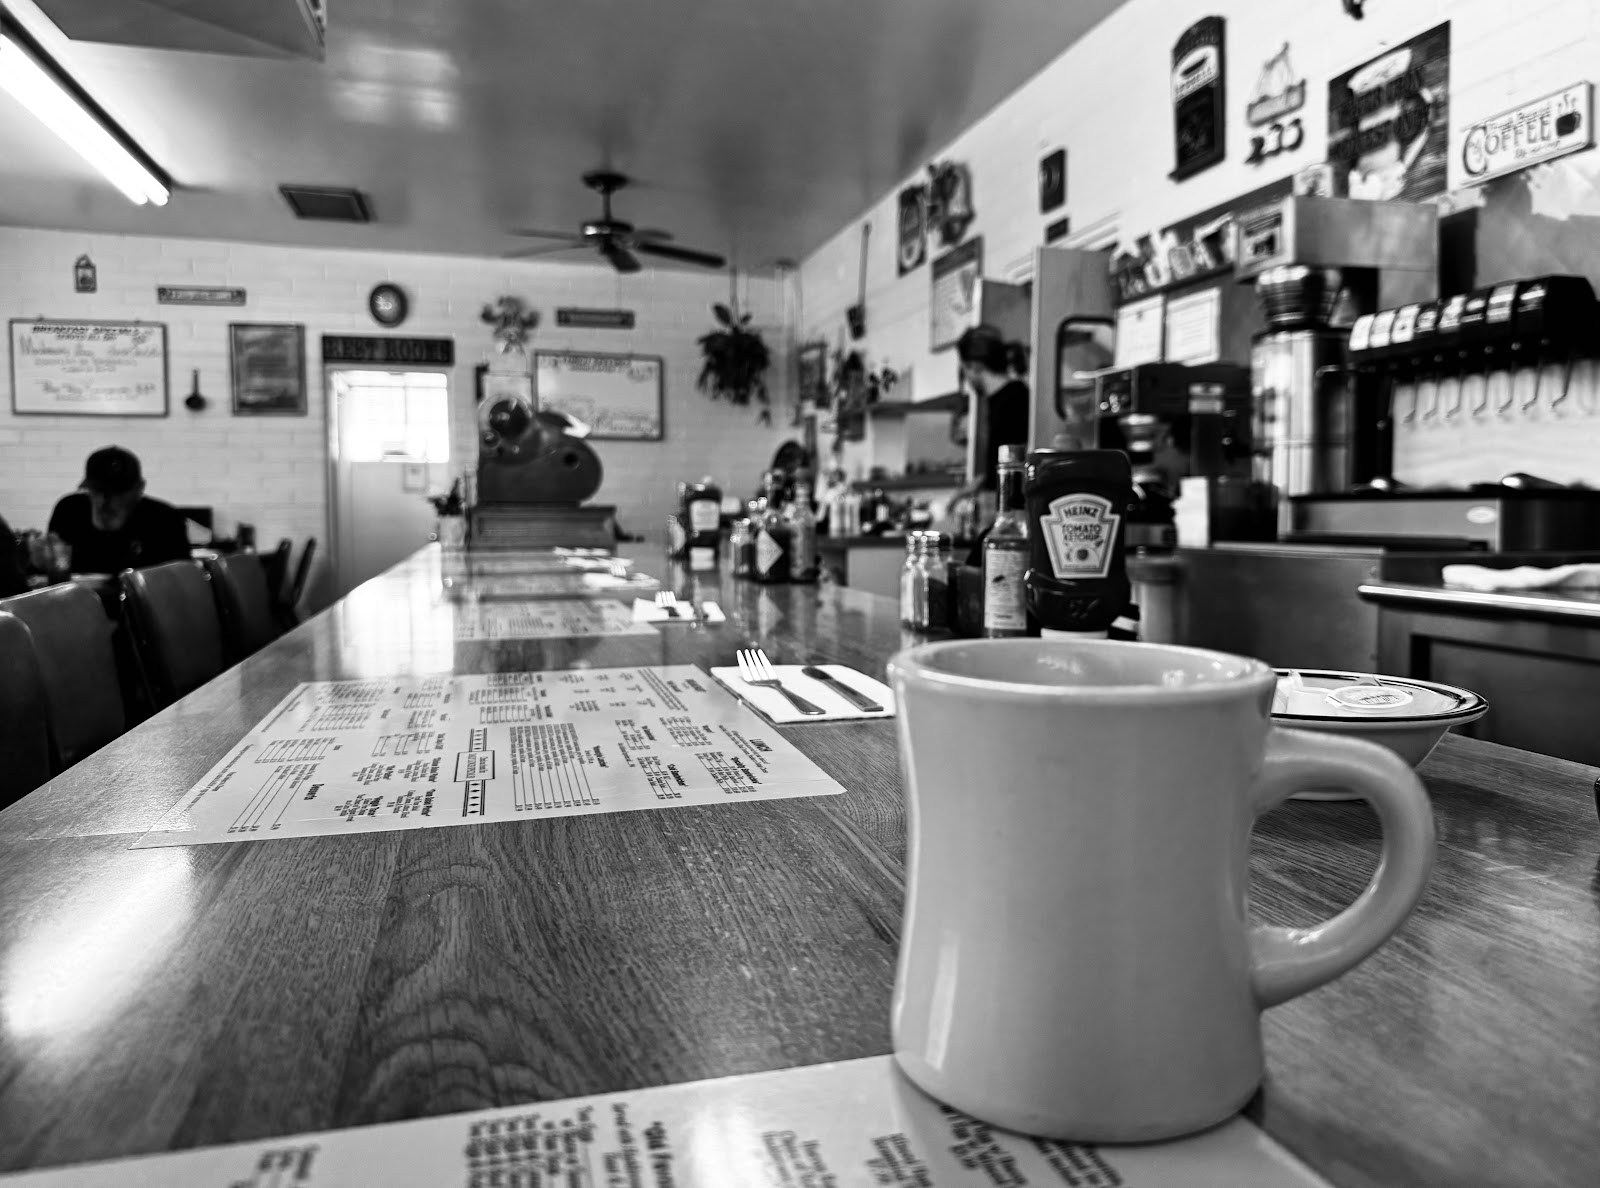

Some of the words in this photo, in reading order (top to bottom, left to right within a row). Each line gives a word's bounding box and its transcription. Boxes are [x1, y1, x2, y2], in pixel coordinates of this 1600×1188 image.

[1463, 117, 1552, 177] COFFEE
[1063, 507, 1099, 518] HEINZ
[1062, 524, 1101, 534] TOMATO
[748, 738, 773, 752] LUNCH
[304, 783, 324, 800] Desserts
